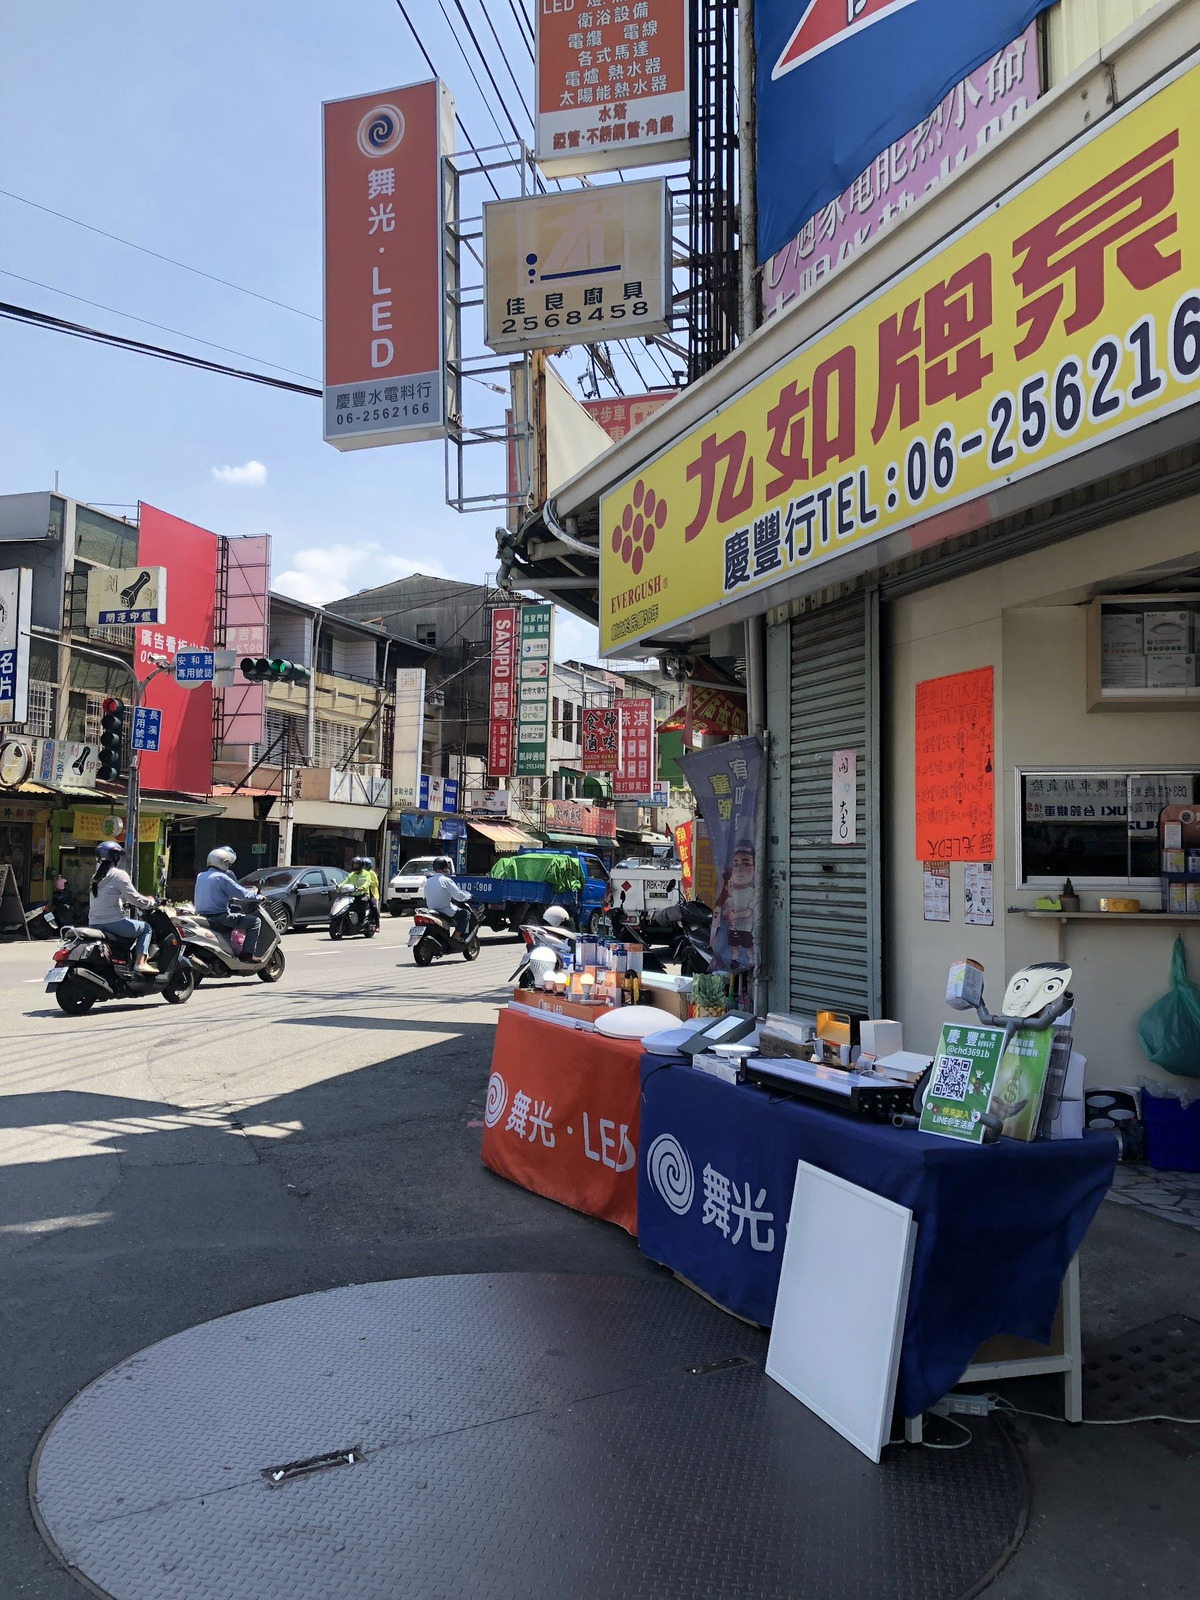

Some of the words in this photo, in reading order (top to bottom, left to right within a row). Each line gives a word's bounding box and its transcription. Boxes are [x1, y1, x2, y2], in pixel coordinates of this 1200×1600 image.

[577, 2, 649, 29] 衛浴設備
[567, 30, 602, 50] 電纜
[623, 19, 658, 41] 電線
[577, 41, 649, 67] 各式馬達
[559, 75, 668, 107] 太陽能熱水器
[598, 102, 628, 123] 水塔
[506, 281, 644, 316] 佳良廚具
[501, 300, 649, 334] 2568458
[335, 381, 432, 411] 慶豐水電料行
[336, 402, 430, 426] 06-2562166
[610, 574, 662, 615] EVERGUSH
[105, 611, 152, 624] 開運印鑑
[141, 628, 210, 657] 廣告看板
[177, 655, 213, 666] 安和路
[177, 668, 213, 679] 專用號誌
[135, 709, 147, 748] 專用號誌
[946, 1029, 980, 1047] 慶豐
[946, 1044, 990, 1059] @chd3691b
